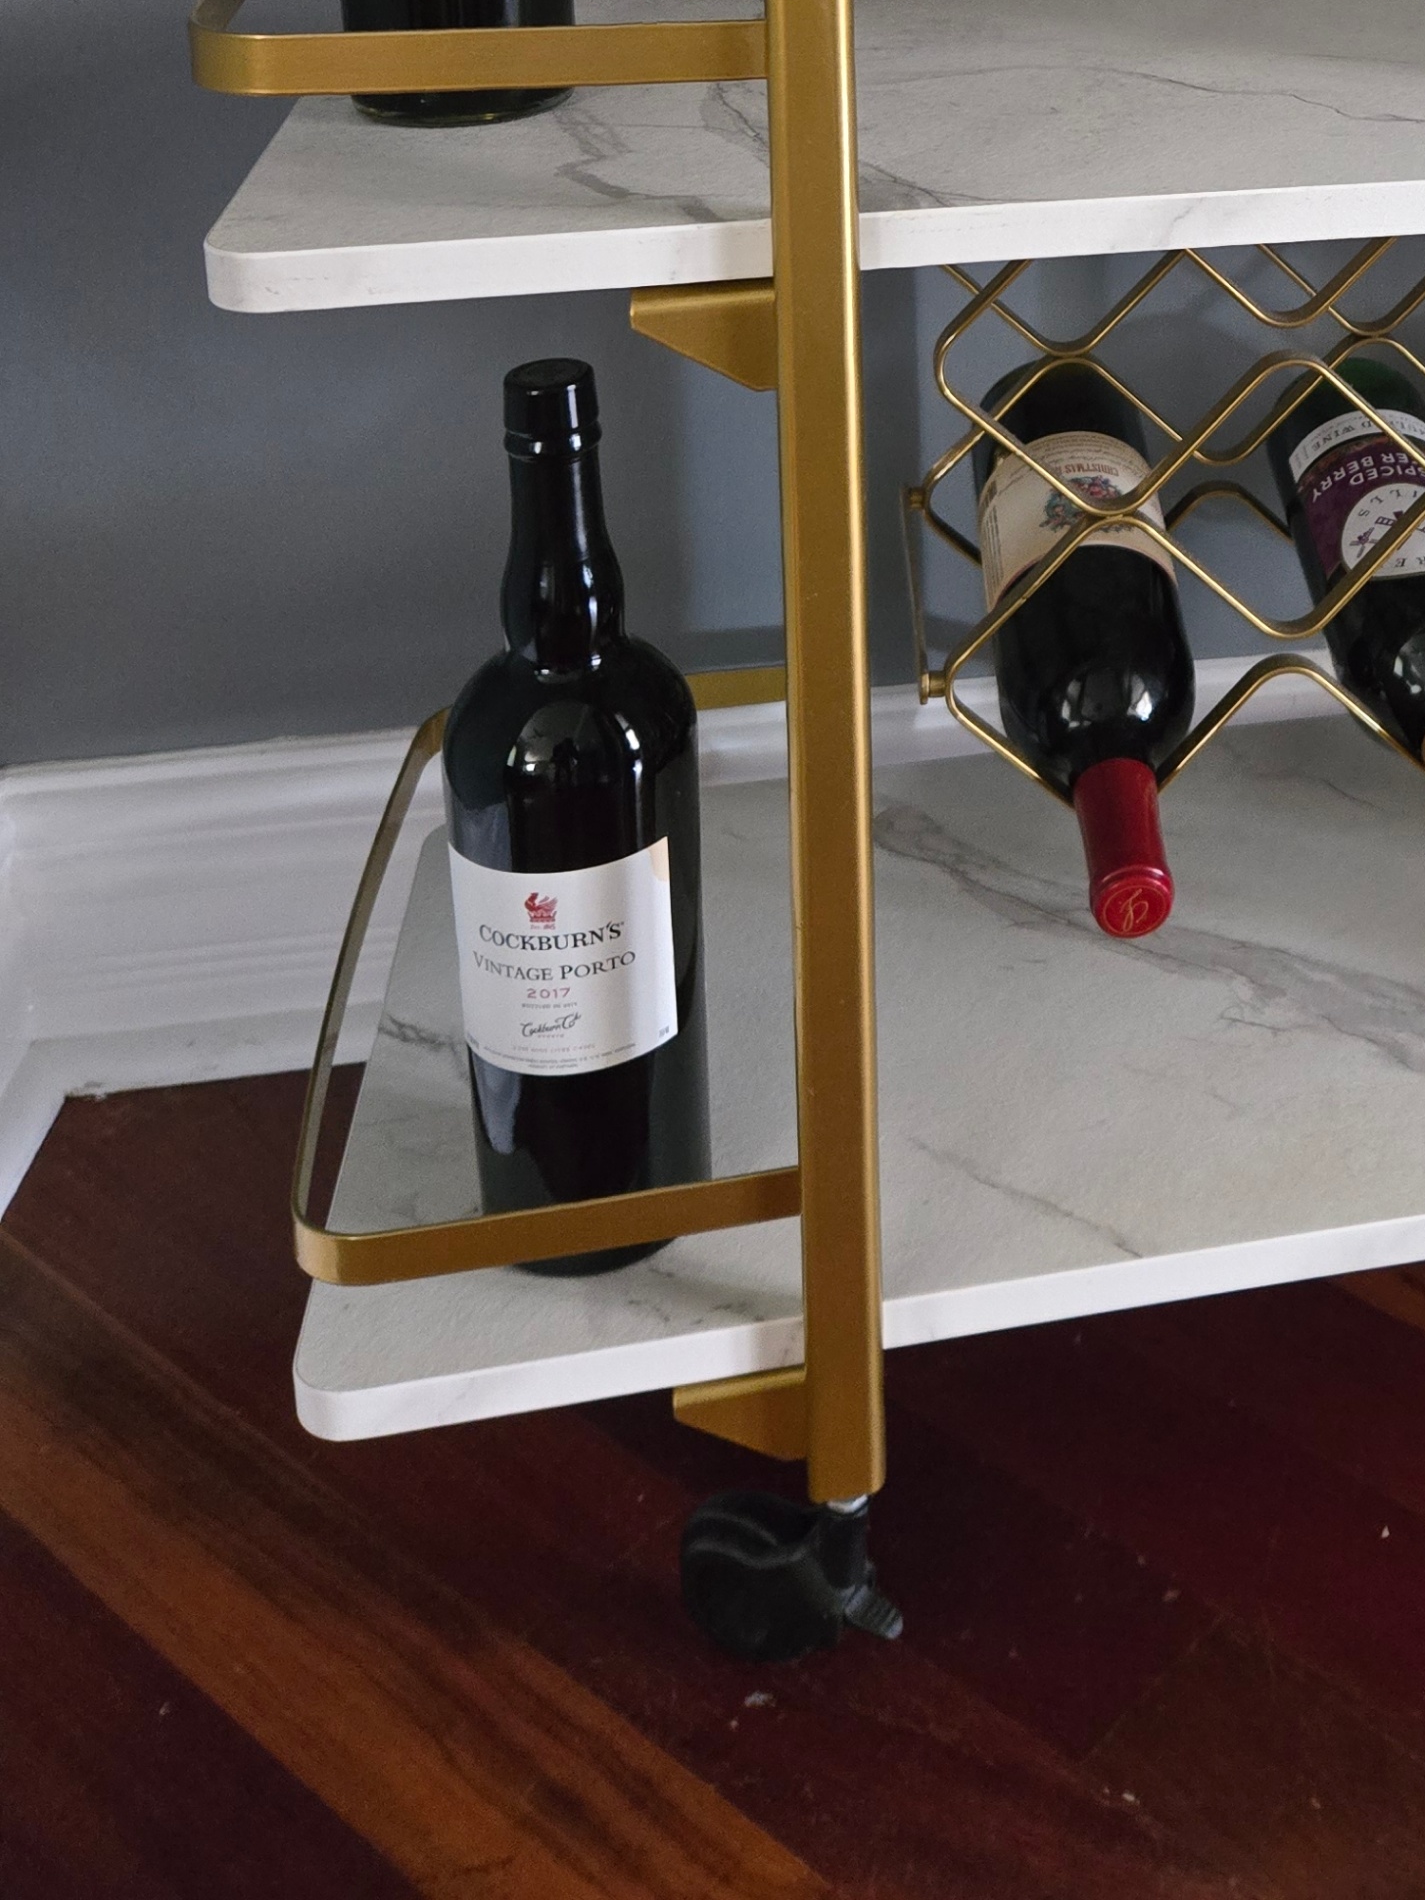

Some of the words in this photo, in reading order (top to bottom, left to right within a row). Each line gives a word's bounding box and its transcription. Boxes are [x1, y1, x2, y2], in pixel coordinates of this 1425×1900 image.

[1310, 425, 1355, 451] WINE
[1312, 455, 1373, 503] BERRY
[1357, 489, 1418, 518] ILLS
[479, 921, 622, 951] COCKBURN'S
[472, 950, 553, 981] VINTAGE
[560, 950, 636, 980] PORTO
[526, 987, 571, 999] 2017
